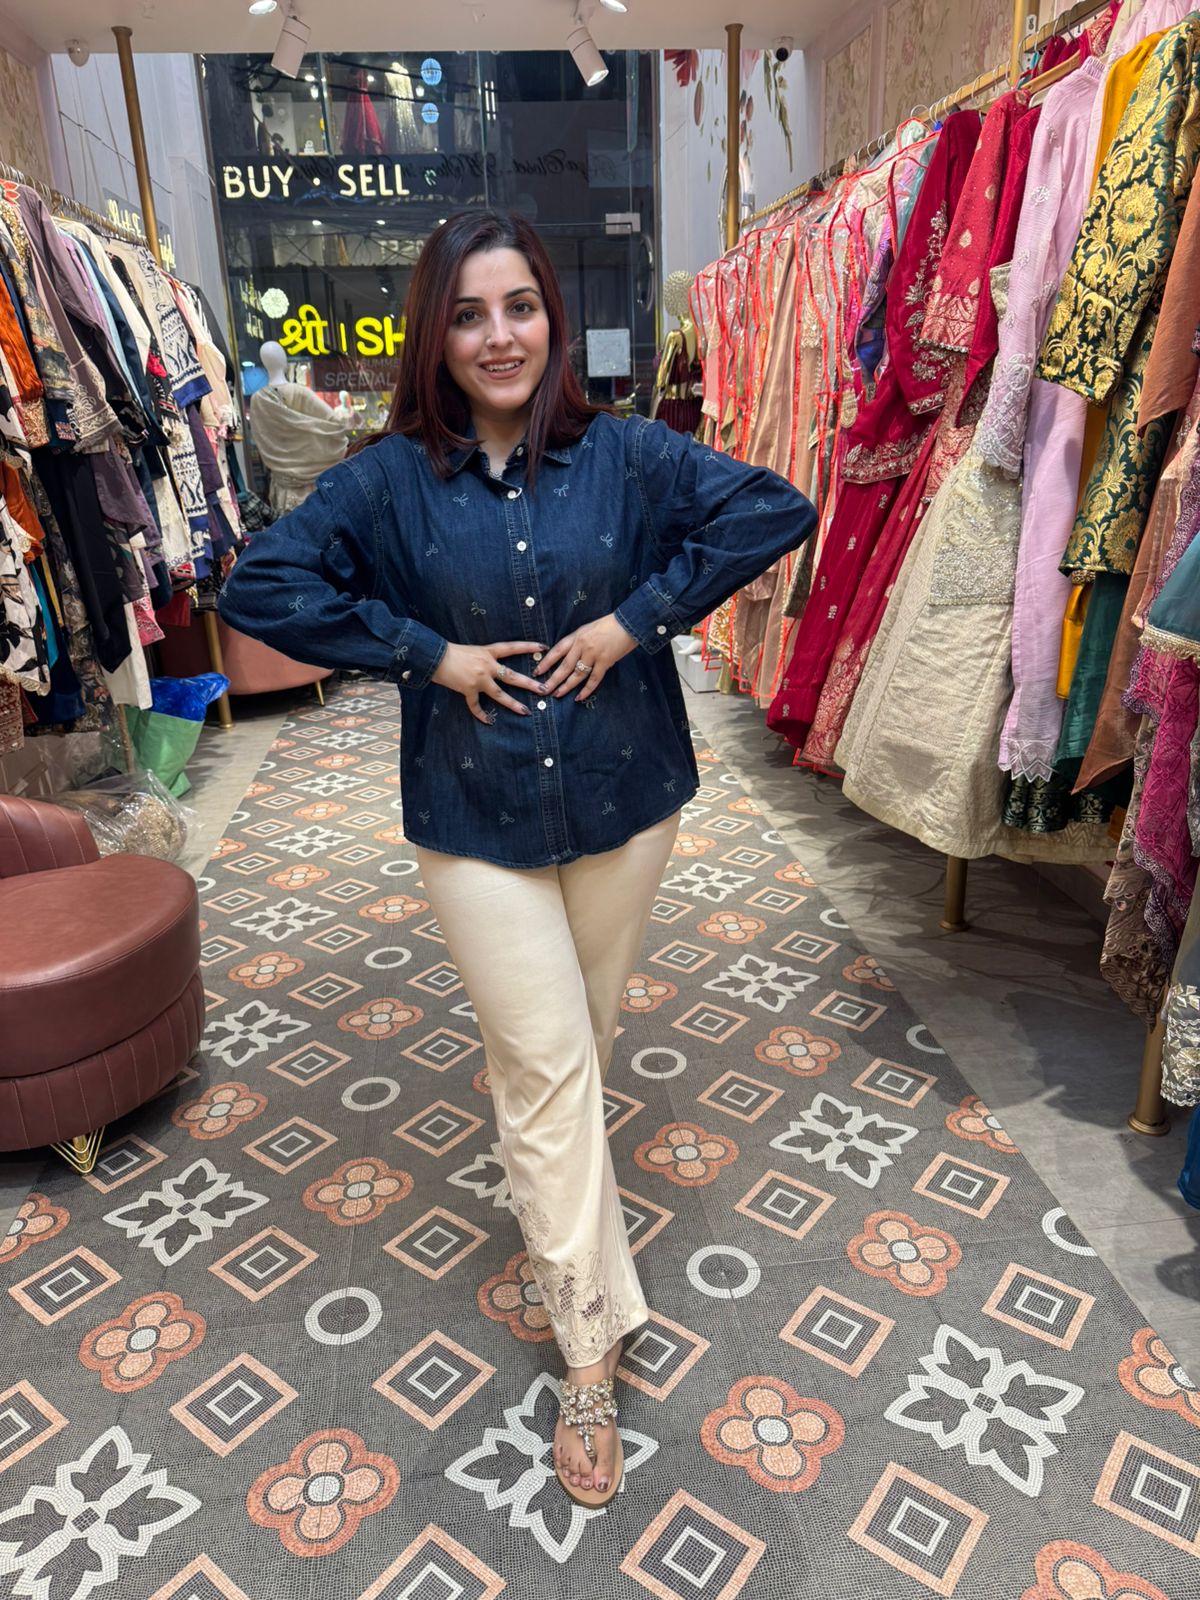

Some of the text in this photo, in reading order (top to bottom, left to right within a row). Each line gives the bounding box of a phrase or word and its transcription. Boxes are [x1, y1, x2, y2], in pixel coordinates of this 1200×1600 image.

[223, 165, 294, 198] BUY
[337, 164, 411, 197] SELL
[278, 304, 331, 355] श्री
